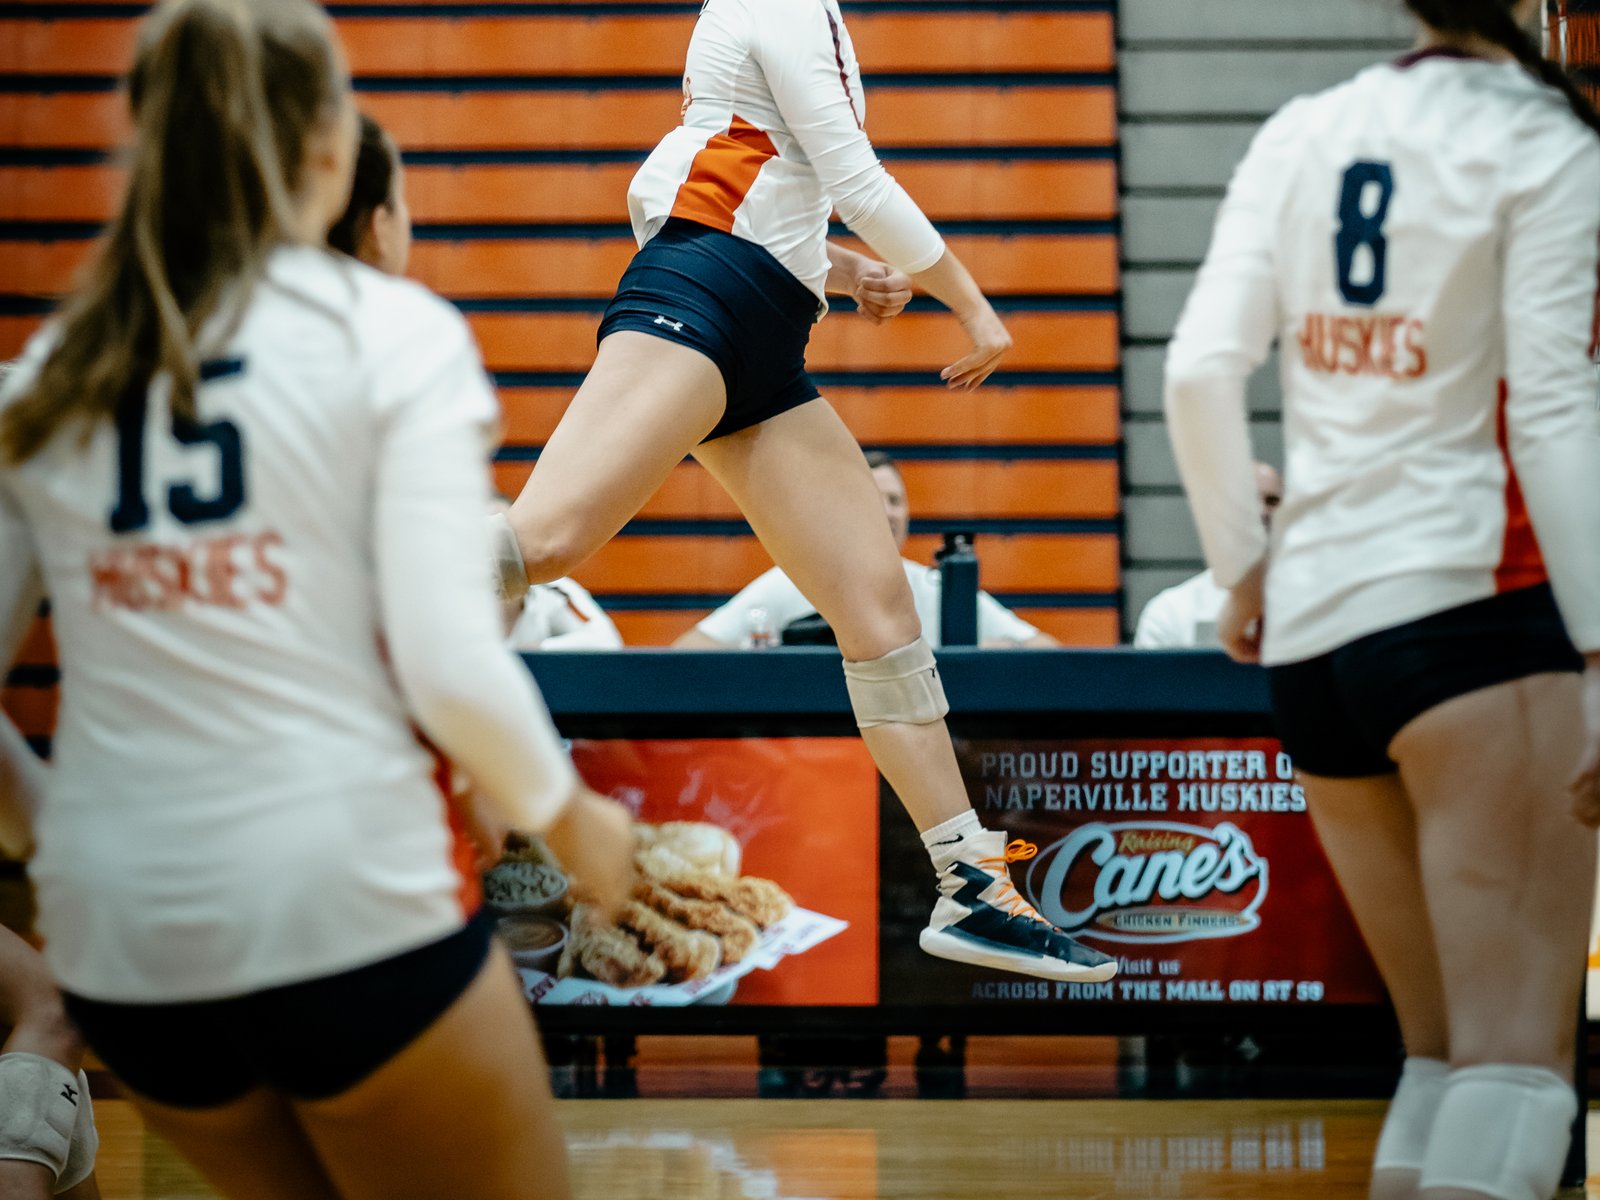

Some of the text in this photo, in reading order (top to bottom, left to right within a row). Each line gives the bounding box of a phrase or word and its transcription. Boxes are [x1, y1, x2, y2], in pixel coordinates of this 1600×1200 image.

[1336, 161, 1394, 305] 8
[1299, 313, 1427, 379] HUSKIES
[109, 358, 247, 533] 15
[981, 751, 1295, 780] PROUD SUPPORTER O
[985, 783, 1306, 811] NAPERVILLE HUSKIES
[1119, 831, 1196, 853] Raising
[1158, 959, 1181, 975] us
[972, 982, 1049, 999] ACROSS
[1055, 982, 1113, 1000] FROM
[1119, 981, 1161, 1000] THE
[1166, 981, 1225, 1001] MALL
[1229, 980, 1260, 1000] ON
[1263, 980, 1294, 1001] RT
